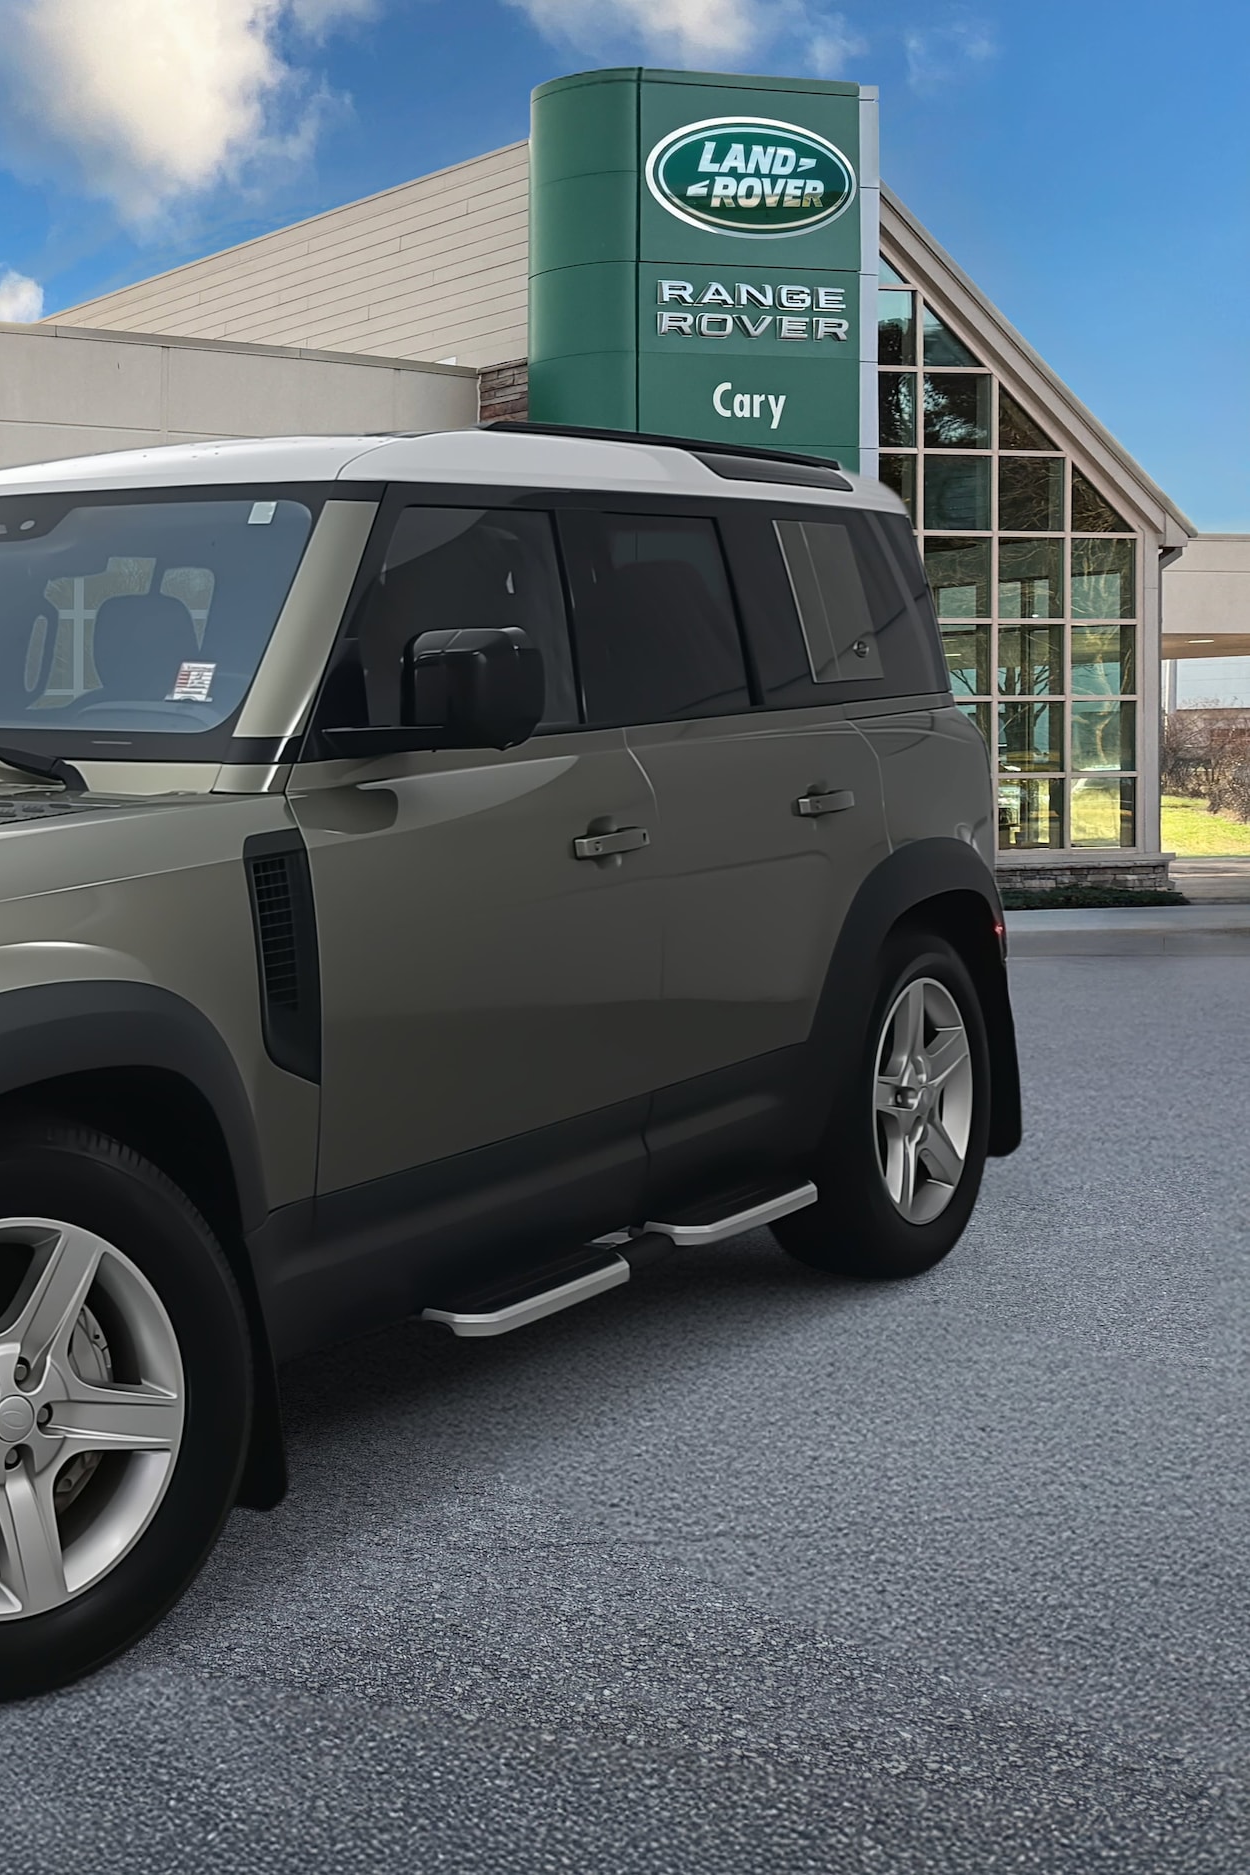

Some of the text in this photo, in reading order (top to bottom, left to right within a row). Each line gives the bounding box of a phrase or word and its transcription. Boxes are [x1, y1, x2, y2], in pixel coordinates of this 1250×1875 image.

[697, 141, 796, 175] LAND
[710, 176, 825, 208] ROVER
[657, 280, 846, 311] RANGE
[657, 311, 849, 342] ROVER
[713, 382, 786, 429] Cary
